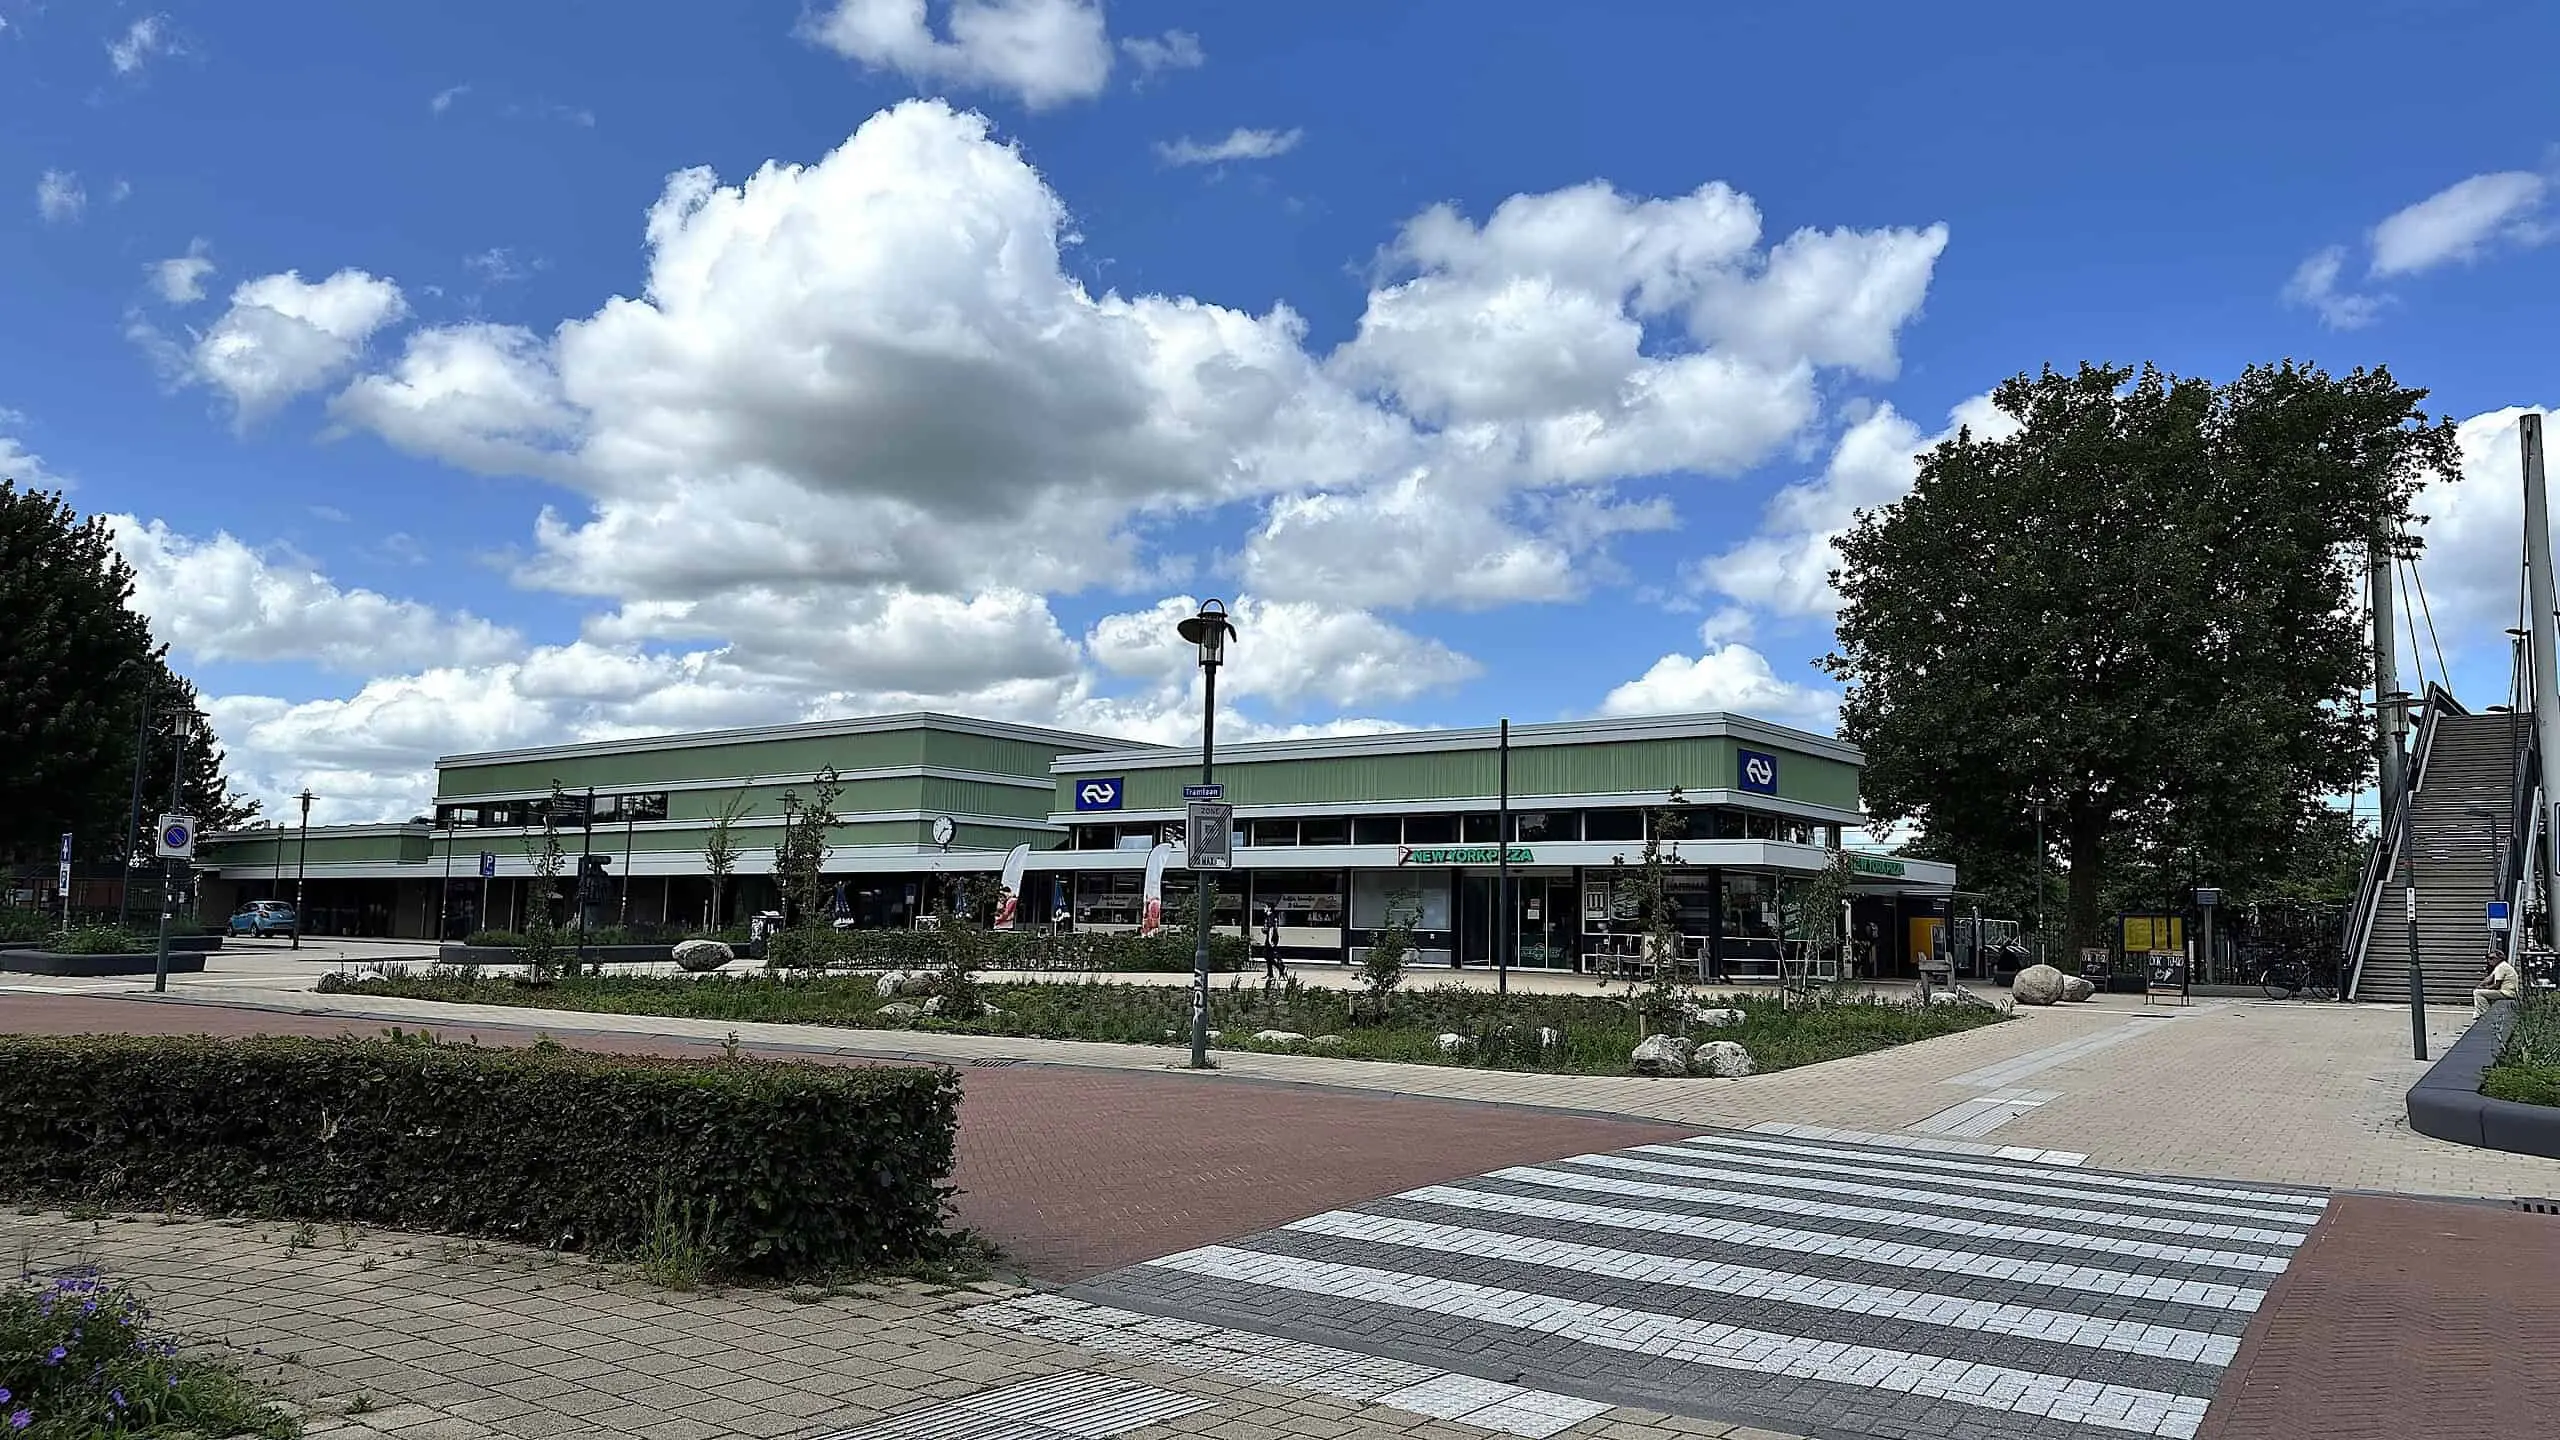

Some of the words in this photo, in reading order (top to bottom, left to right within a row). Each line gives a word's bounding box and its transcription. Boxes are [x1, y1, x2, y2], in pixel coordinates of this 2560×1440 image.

[1185, 788, 1218, 797] Tramlaan
[1200, 807, 1221, 815] ZONE
[486, 855, 494, 869] P
[1412, 850, 1445, 863] NEW
